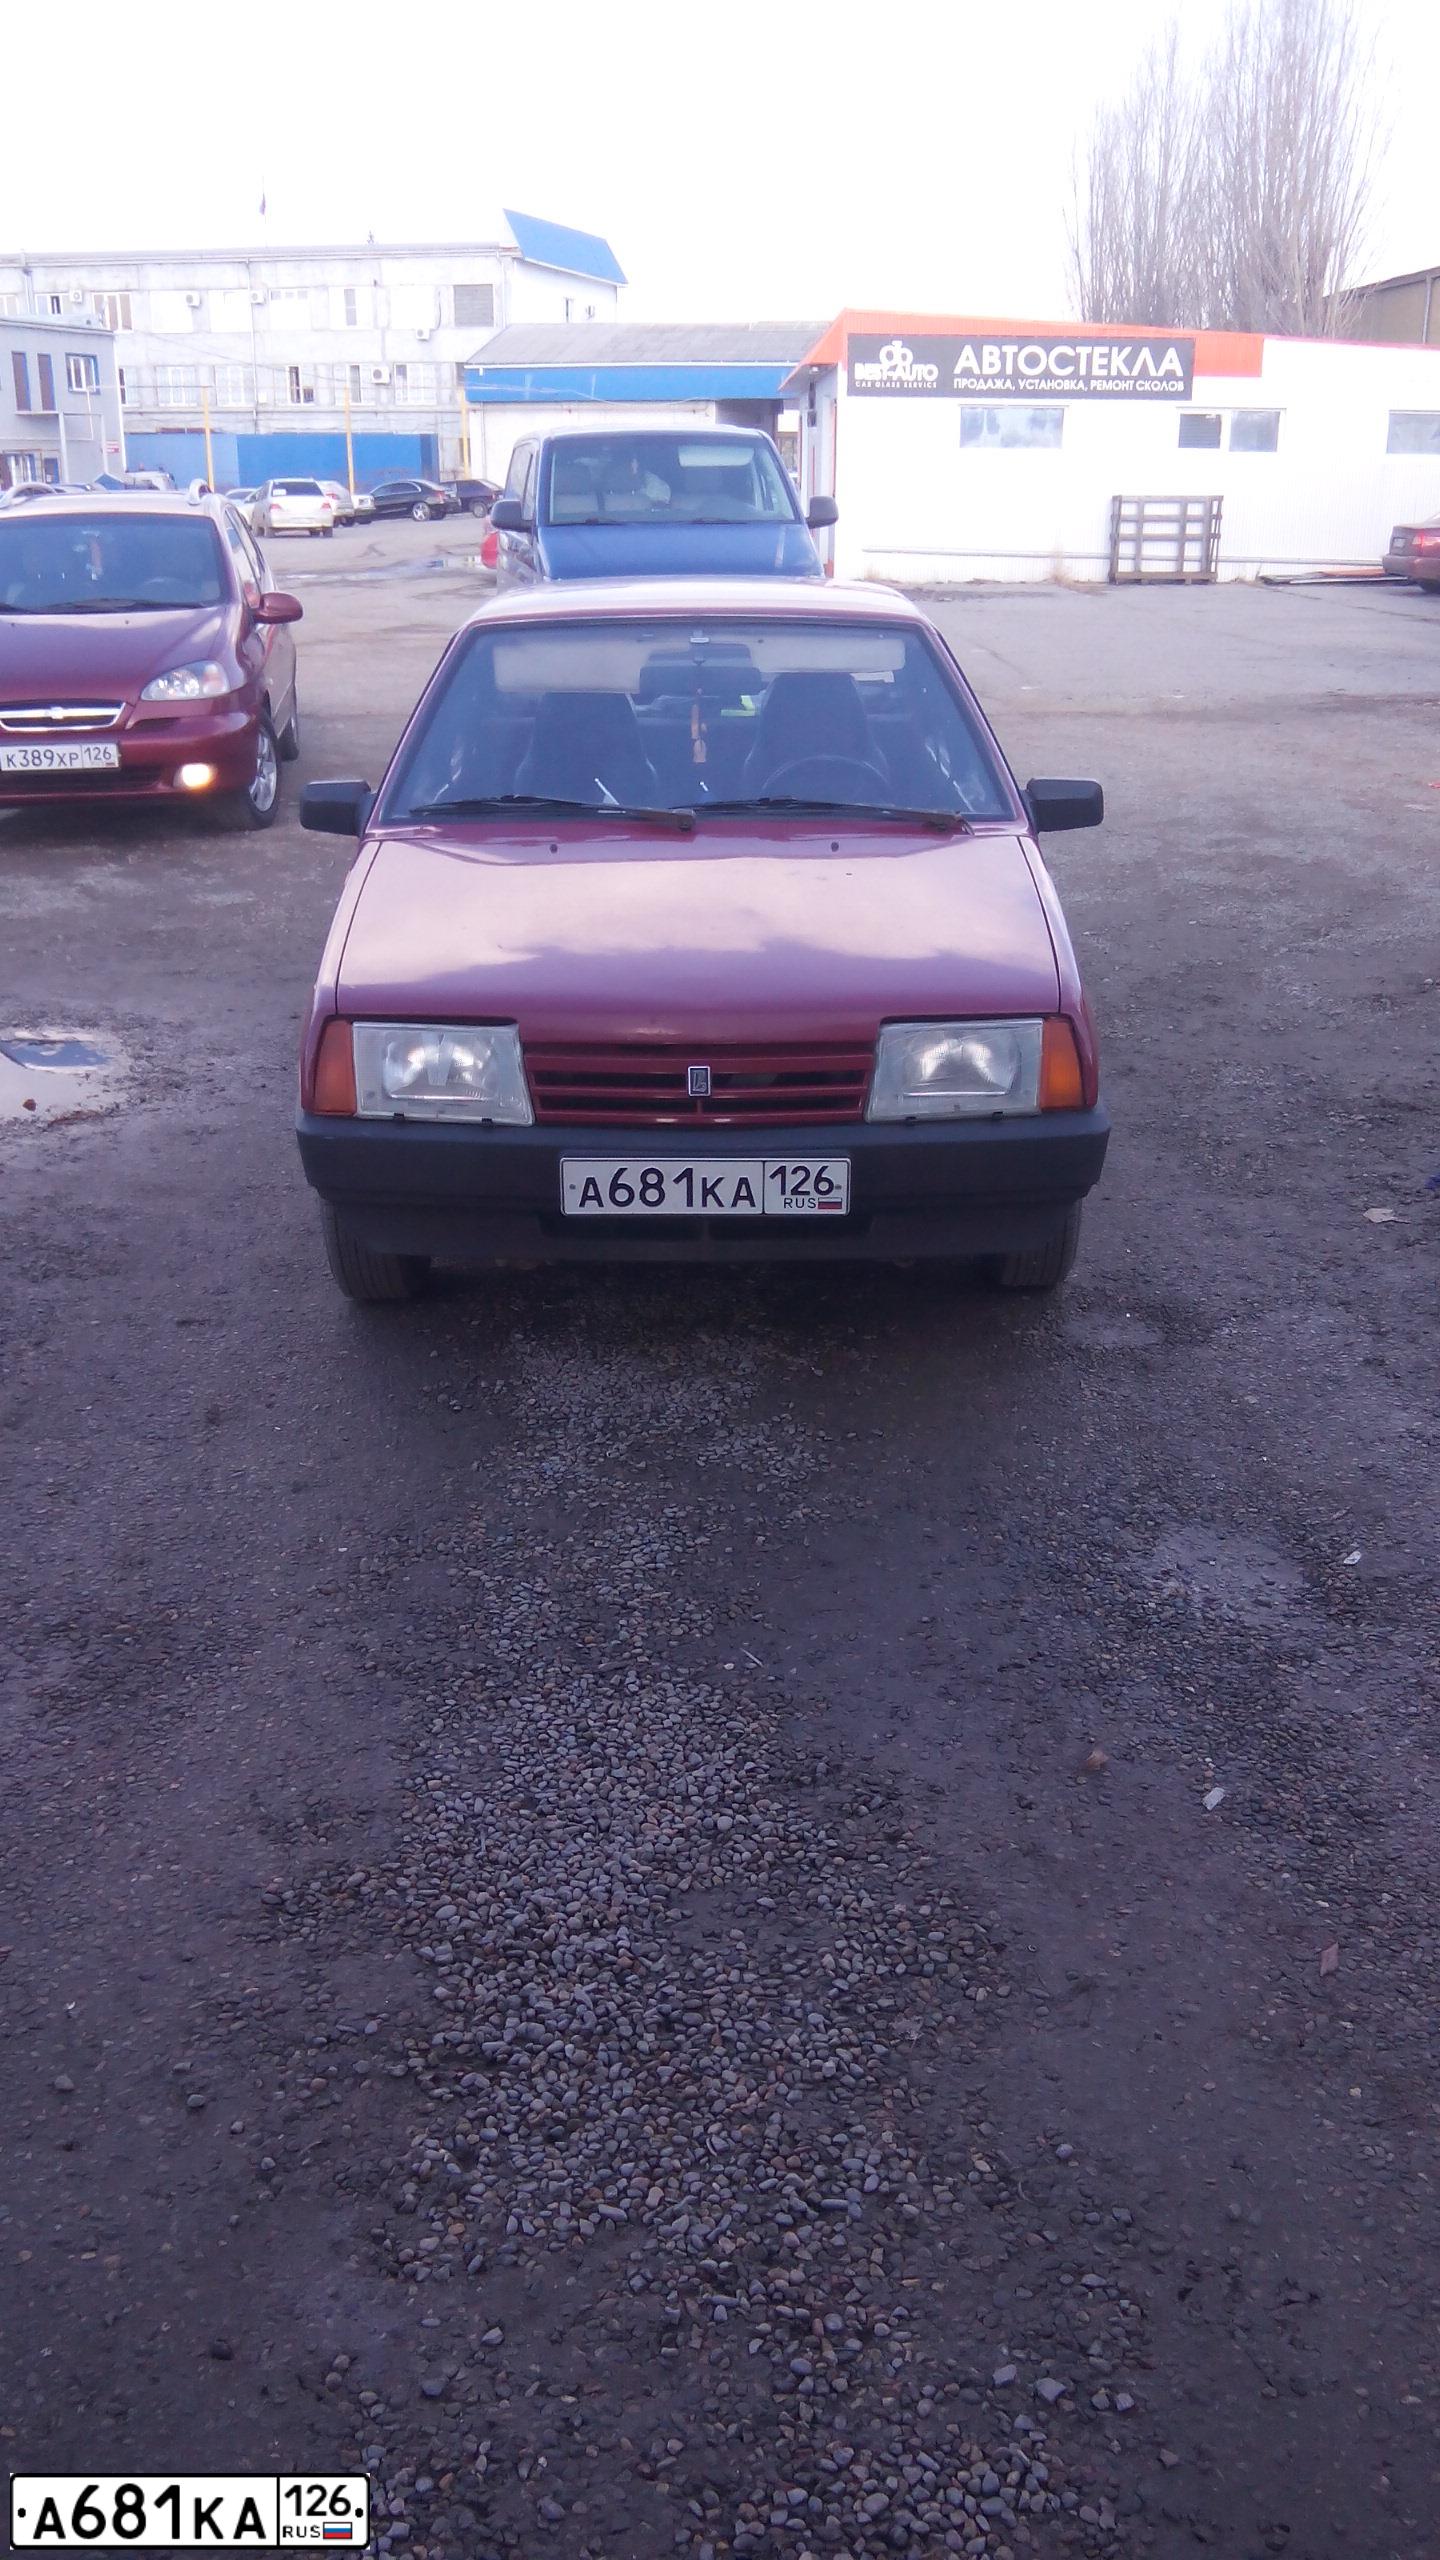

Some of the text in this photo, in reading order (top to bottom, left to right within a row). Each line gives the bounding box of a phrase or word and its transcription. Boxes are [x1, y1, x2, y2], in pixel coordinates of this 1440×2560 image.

[953, 344, 1184, 377] АВТОСТЕКЛА
[953, 378, 1185, 392] ПРОДАЖА, УСТАНОВКА, РЕМОНТ СКОЛОВ
[6, 747, 112, 768] К389ХР 126
[578, 1165, 835, 1208] А681КА 126
[783, 1197, 817, 1209] RUS
